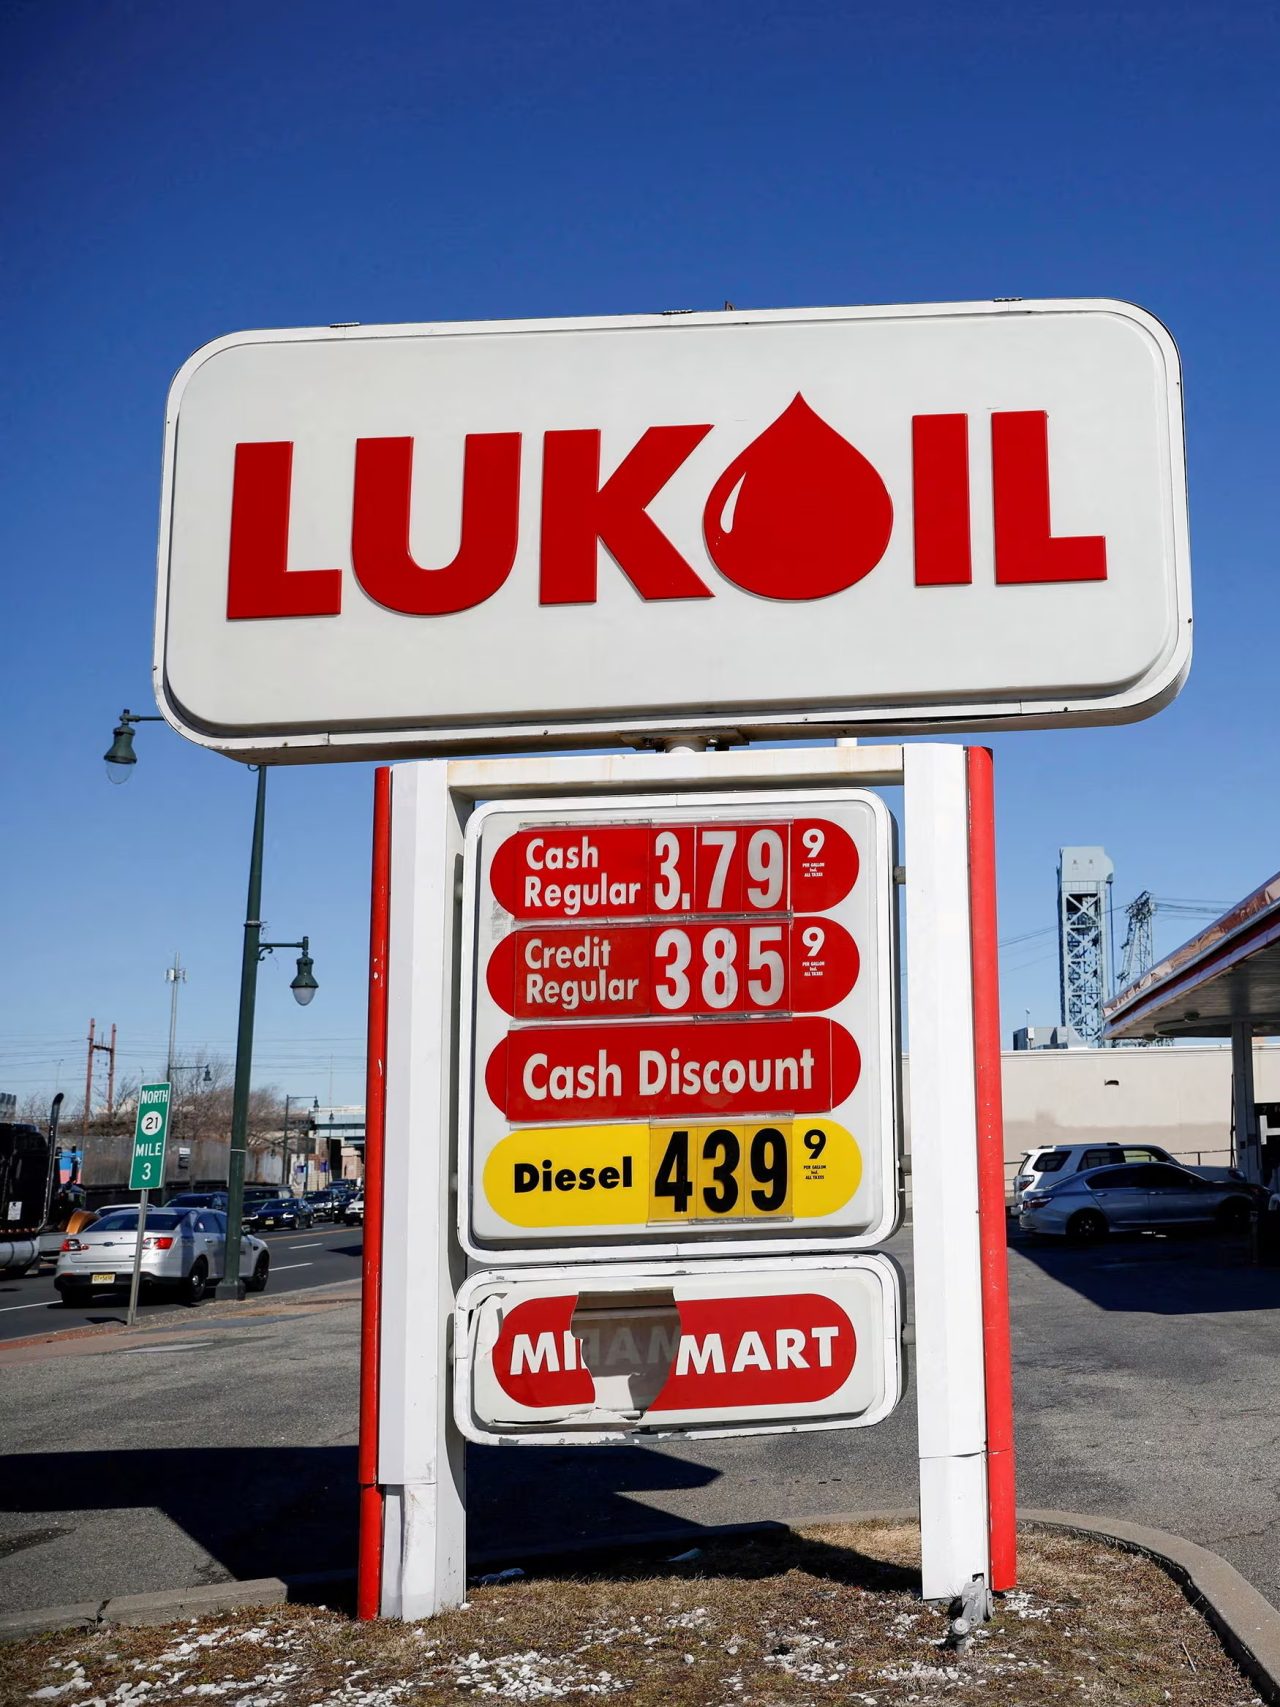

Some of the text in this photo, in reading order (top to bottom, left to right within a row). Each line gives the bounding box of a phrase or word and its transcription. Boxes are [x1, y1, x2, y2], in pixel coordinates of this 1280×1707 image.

[227, 391, 1107, 620] LUKOIL
[525, 836, 598, 870] Cash
[654, 828, 825, 910] 3.79 9
[525, 873, 641, 916] Regular
[525, 936, 612, 968] Credit
[655, 926, 825, 1010] 385 9
[525, 970, 639, 1009] Regular
[523, 1047, 815, 1100] Cash Discount
[141, 1089, 169, 1104] NORTH
[145, 1116, 159, 1130] 21
[135, 1142, 162, 1157] MILE
[141, 1162, 151, 1180] 3
[513, 1155, 632, 1194] Diesel
[654, 1128, 826, 1213] 439 9
[675, 1327, 839, 1376] MART
